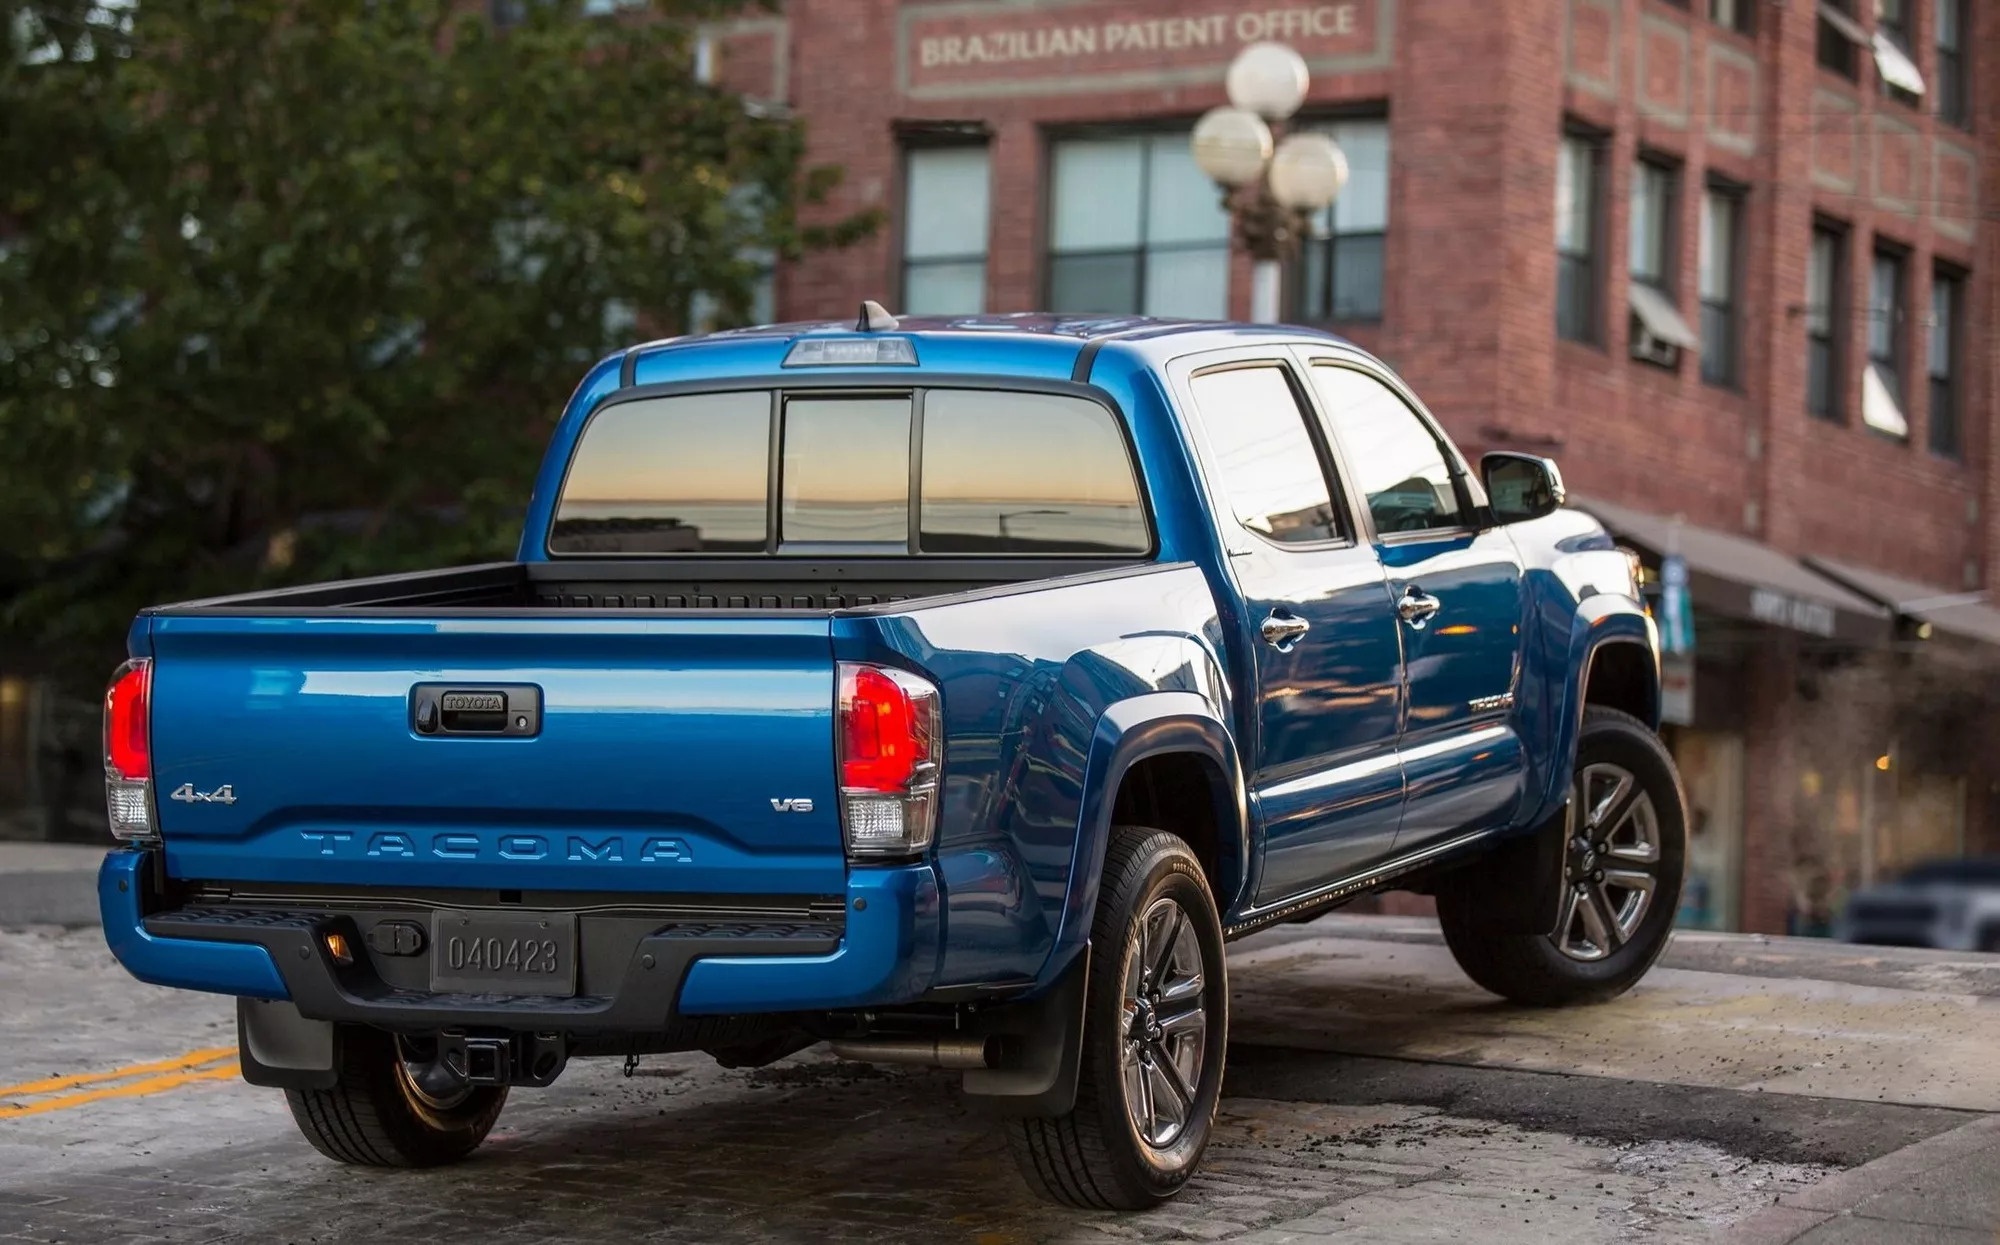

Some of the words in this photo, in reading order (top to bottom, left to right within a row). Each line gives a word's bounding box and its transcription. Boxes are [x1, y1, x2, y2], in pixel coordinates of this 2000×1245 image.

[921, 26, 1096, 67] BRAZILIAN
[1104, 14, 1228, 52] PATENT
[1235, 5, 1356, 41] OFFICE
[446, 695, 501, 710] TOYOTA
[770, 798, 813, 812] V6
[300, 830, 693, 863] TACOMA
[449, 936, 557, 973] 040423
